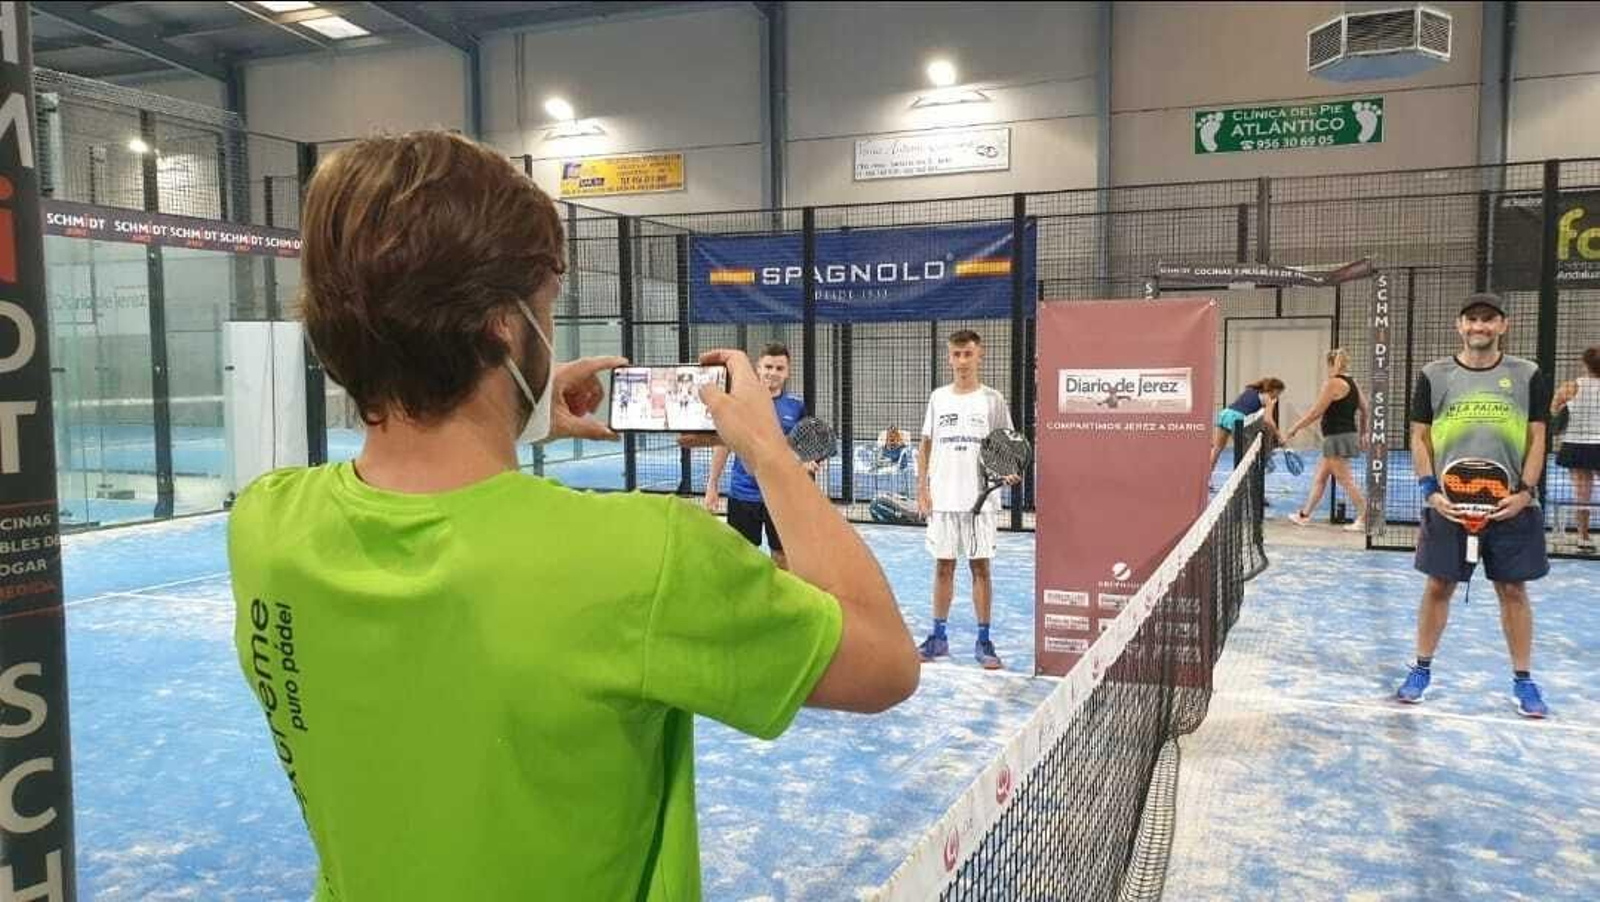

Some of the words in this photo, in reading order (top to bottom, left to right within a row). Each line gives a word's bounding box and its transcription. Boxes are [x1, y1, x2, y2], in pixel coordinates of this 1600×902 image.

[1291, 107, 1317, 117] DEL
[1231, 117, 1345, 137] ATLÁNTICO
[1257, 139, 1279, 150] 956
[1318, 135, 1334, 145] 05
[1066, 377, 1111, 393] Diario
[1115, 378, 1135, 393] de
[1138, 378, 1178, 397] Jerez
[1047, 422, 1121, 431] COMPARTIMOS
[1124, 422, 1155, 431] JEREZ
[1168, 422, 1205, 431] DIARIO
[273, 602, 299, 673] pádel
[285, 680, 308, 731] puro
